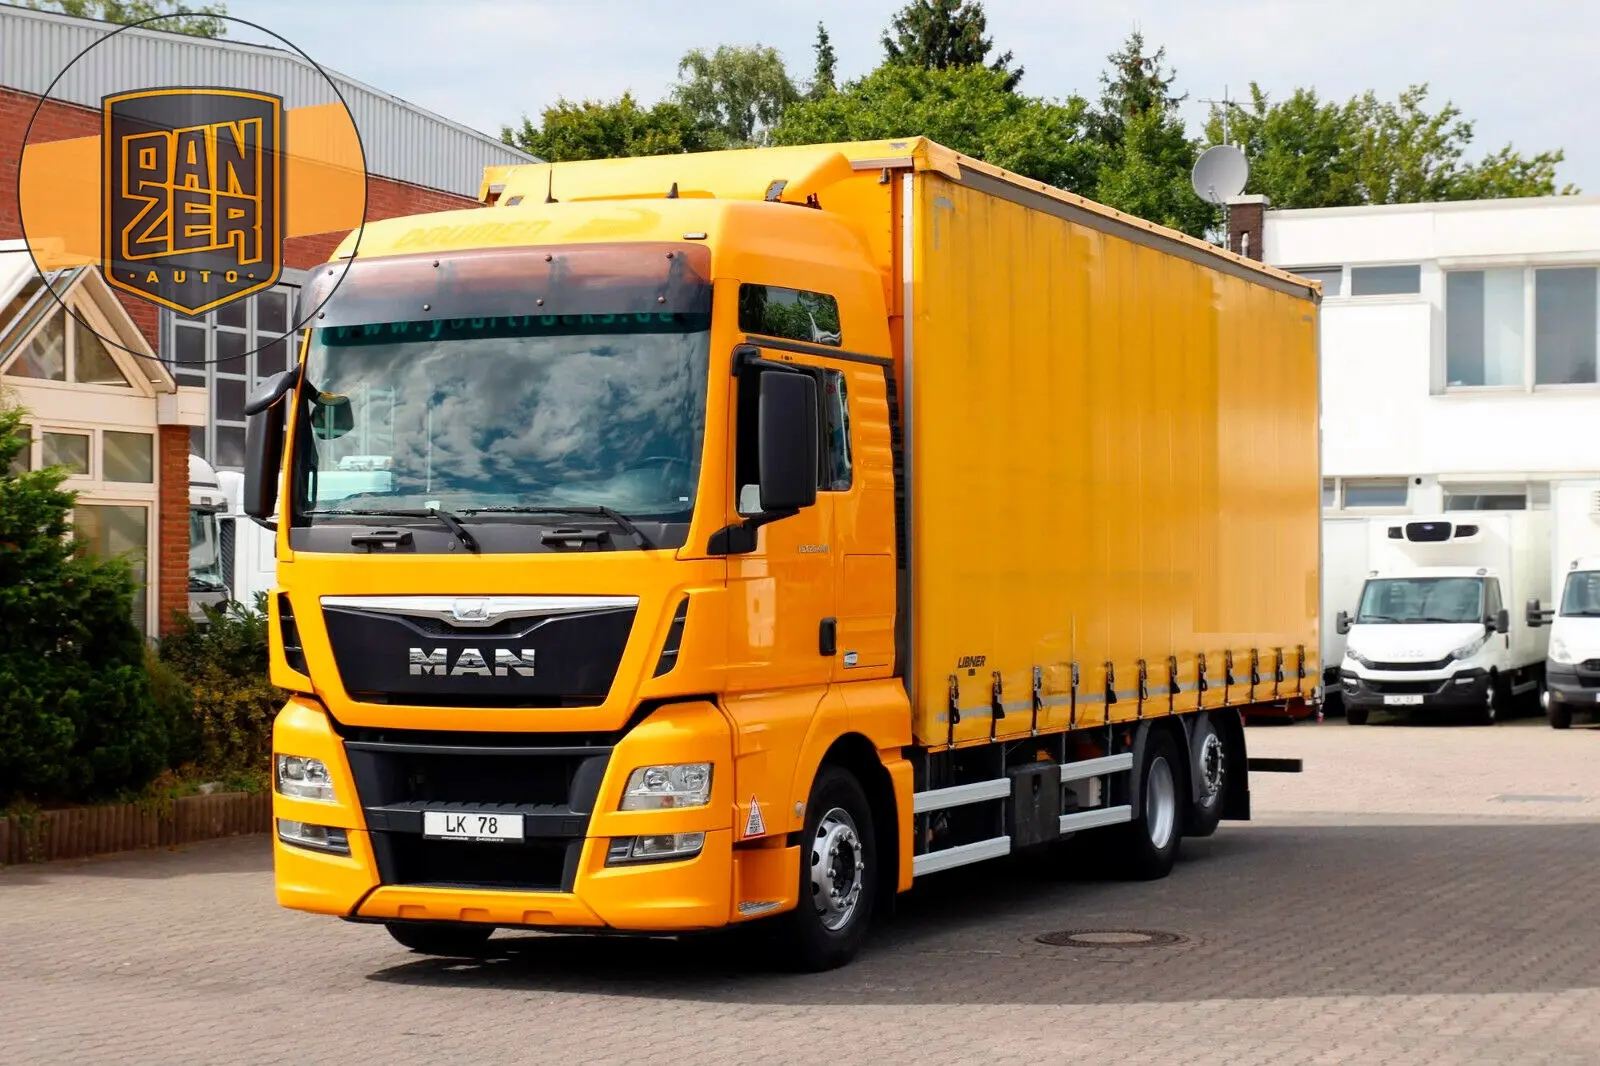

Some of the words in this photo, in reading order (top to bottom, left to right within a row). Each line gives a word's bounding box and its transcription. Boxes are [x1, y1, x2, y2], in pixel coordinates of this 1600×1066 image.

[409, 647, 535, 676] MAN
[958, 655, 986, 669] LIBNER
[446, 815, 466, 833] LK
[478, 816, 498, 834] 78
